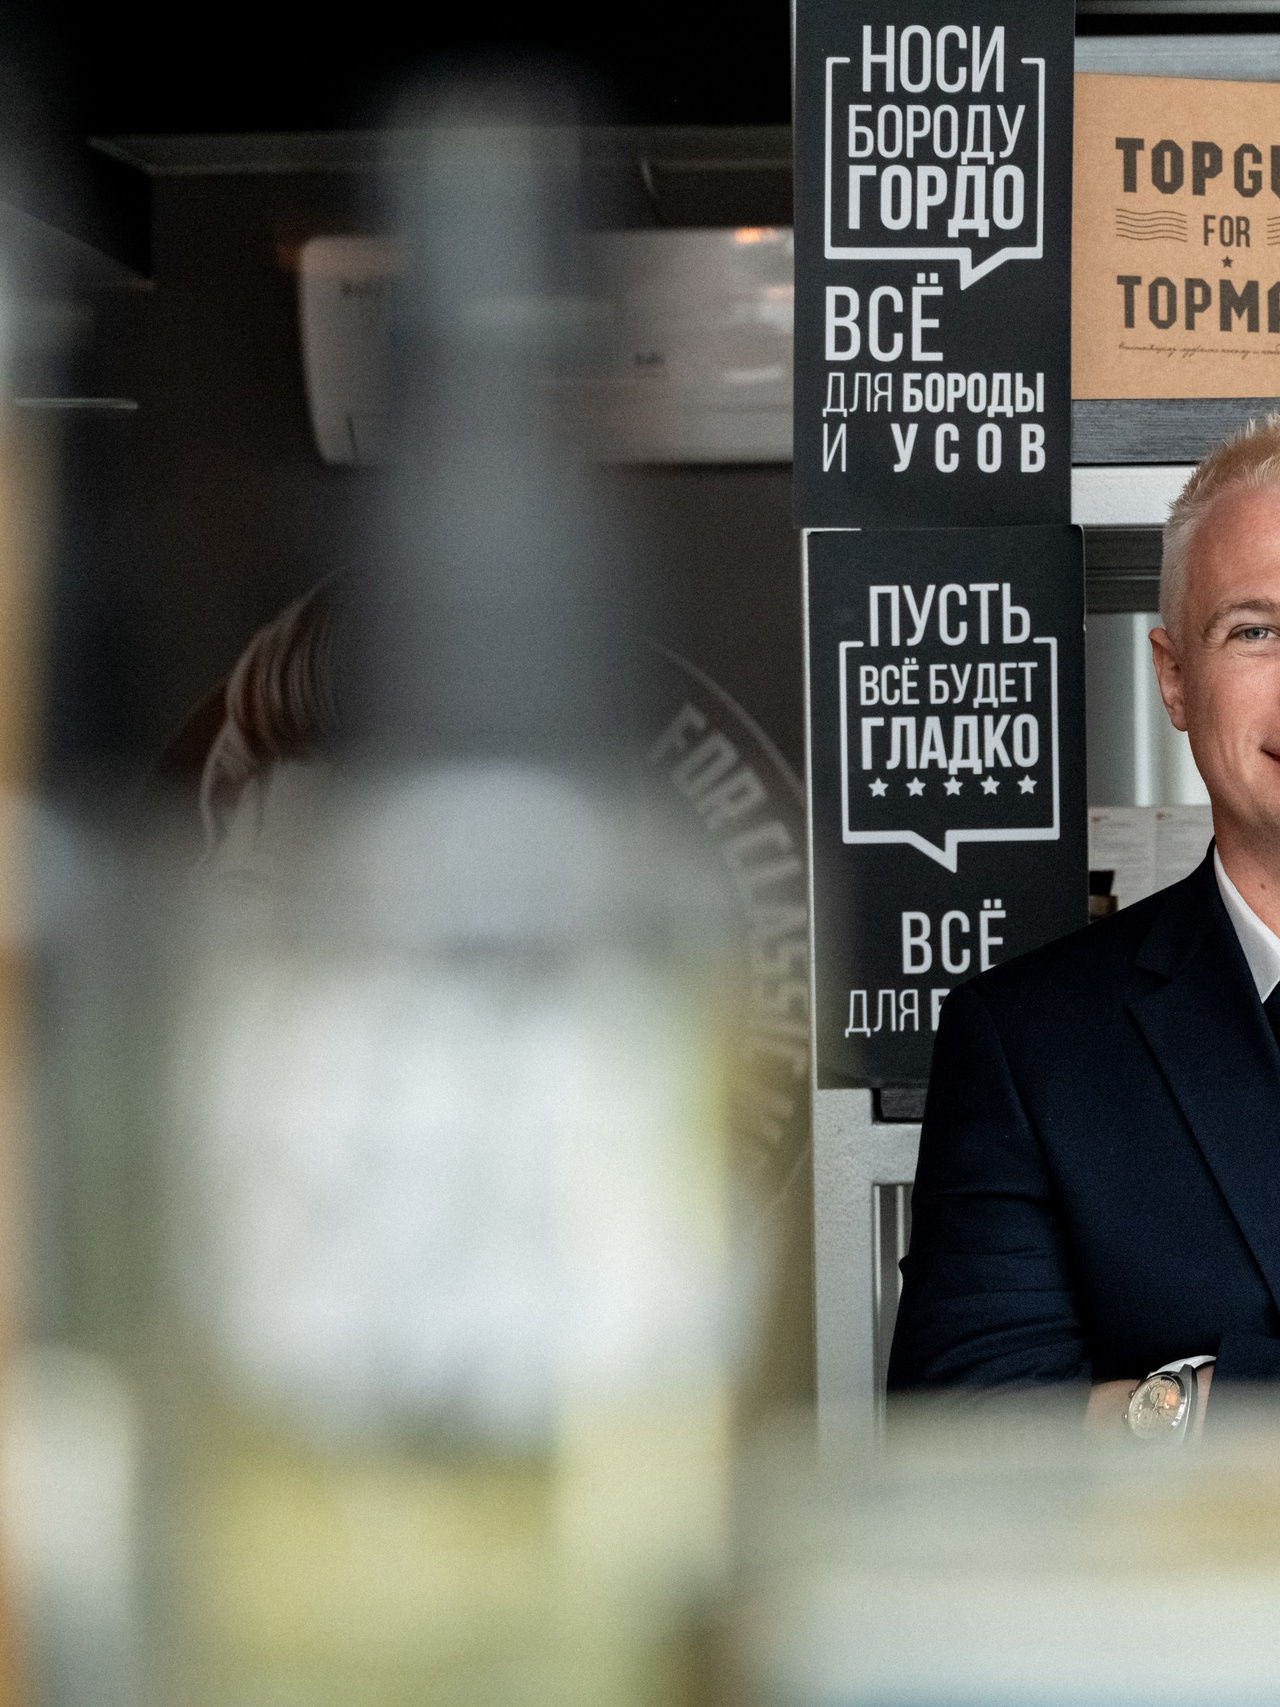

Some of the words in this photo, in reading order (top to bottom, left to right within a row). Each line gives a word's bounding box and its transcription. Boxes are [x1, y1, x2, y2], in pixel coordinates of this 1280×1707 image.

[862, 25, 1005, 93] НОСИ
[848, 104, 1026, 165] БОРОДУ
[848, 165, 1025, 238] ГОРДО
[1203, 214, 1251, 248] FOR
[825, 273, 944, 362] ВСЁ
[822, 372, 893, 418] ДЛЯ
[902, 372, 1045, 418] БОРОДЫ
[822, 423, 847, 473] И
[890, 423, 1046, 473] УСОВ
[869, 582, 1031, 647] ПУСТЬ
[859, 658, 920, 706] ВСЁ
[929, 661, 1038, 709] БУДЕТ
[861, 713, 1040, 775] ГЛАДКО
[902, 899, 1007, 975] ВСЁ
[845, 989, 919, 1038] ДЛЯ
